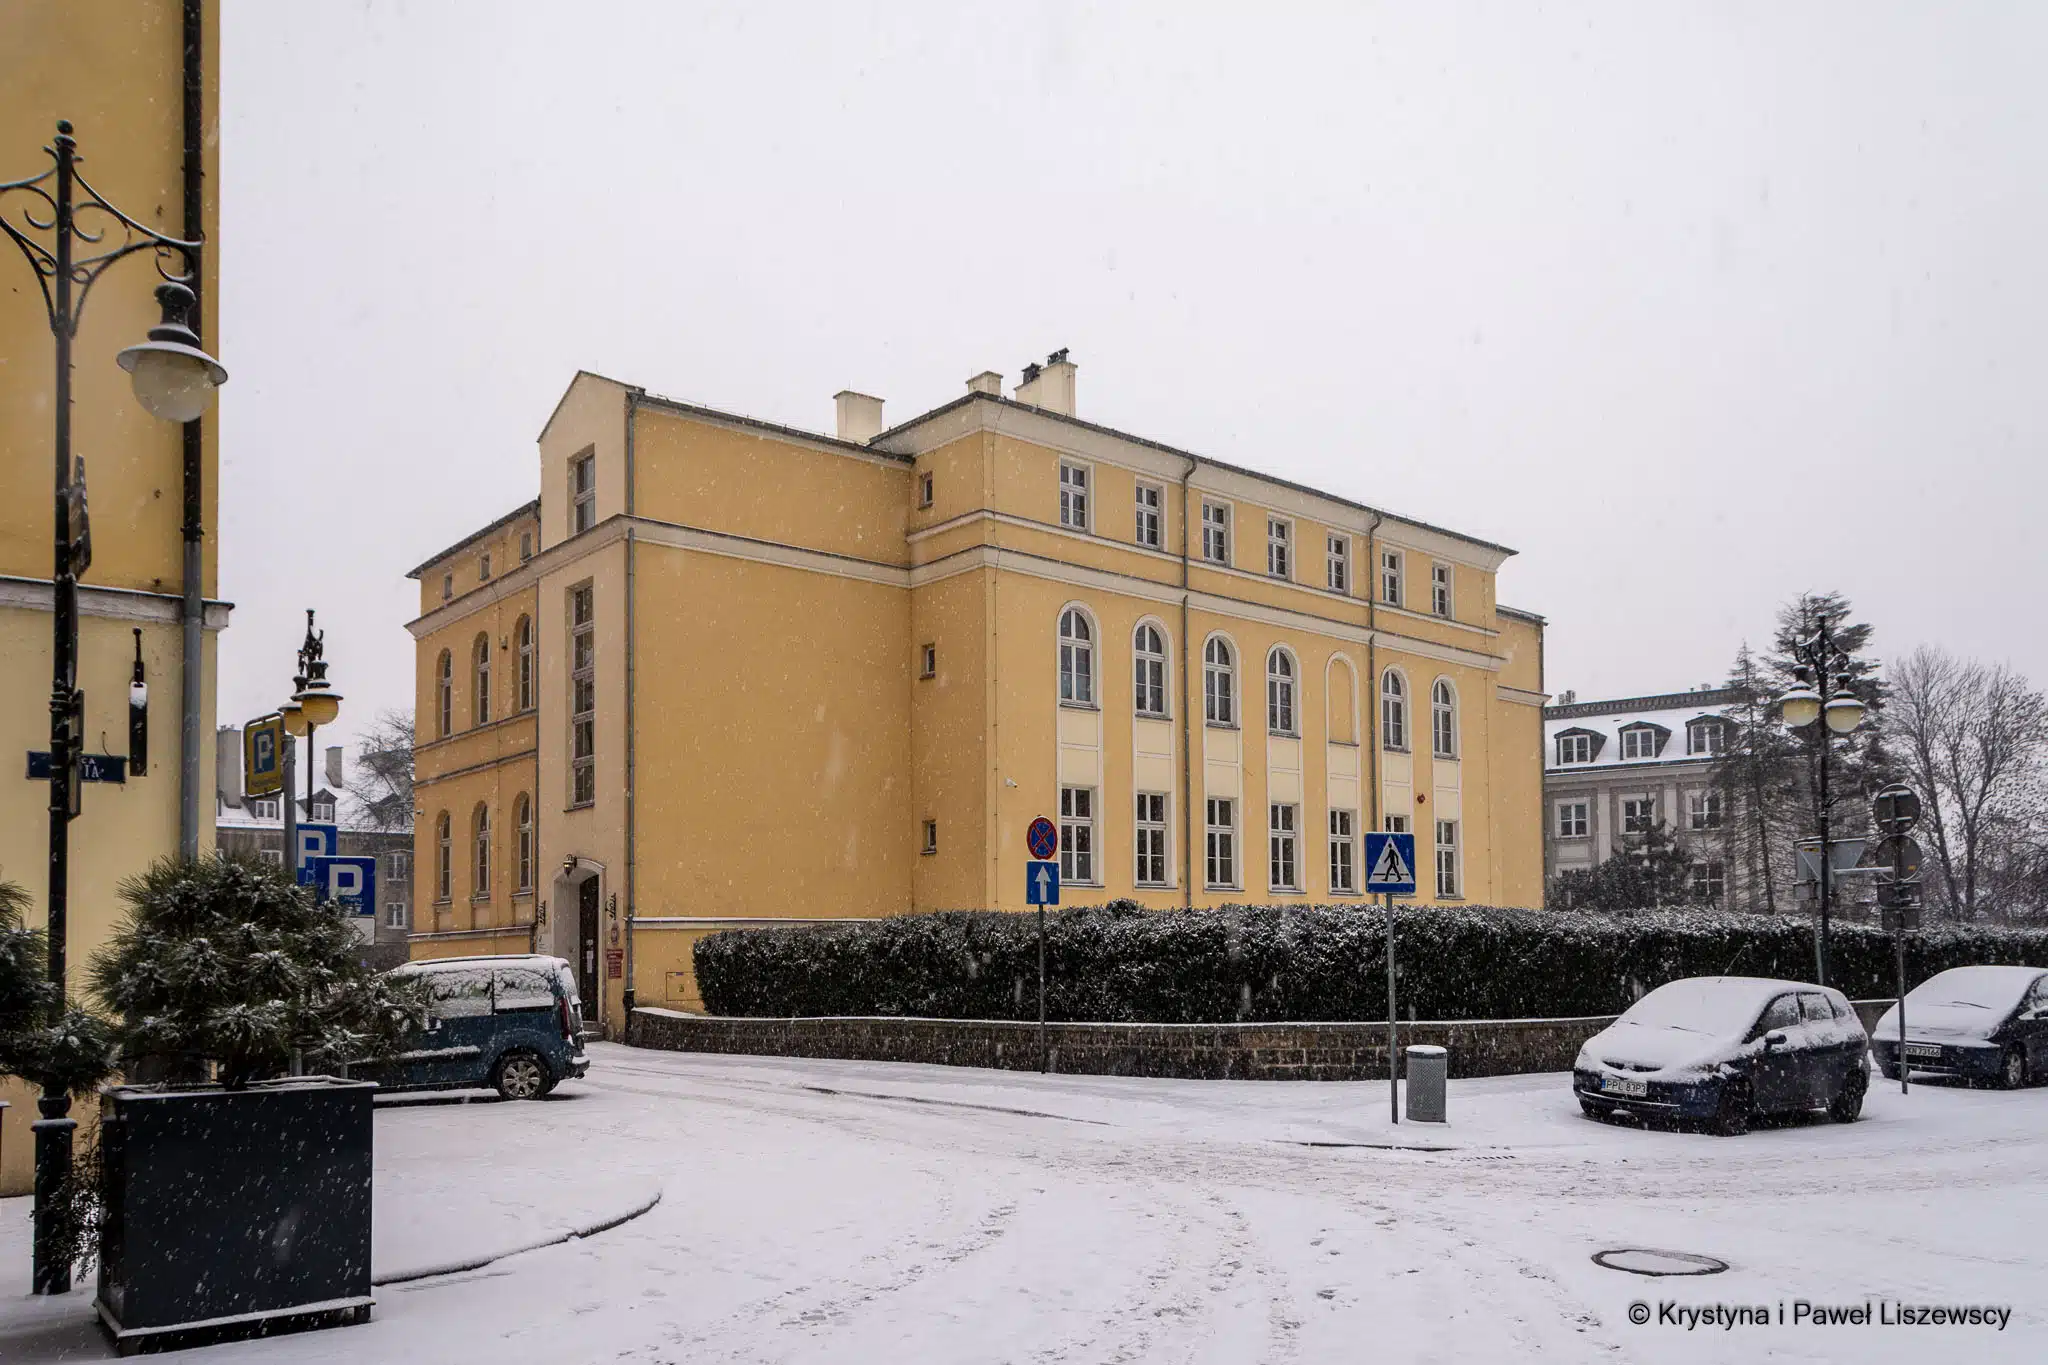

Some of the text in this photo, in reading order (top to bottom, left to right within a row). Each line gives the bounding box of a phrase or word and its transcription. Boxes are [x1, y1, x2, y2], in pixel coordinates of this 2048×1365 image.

[257, 734, 271, 769] P
[298, 829, 327, 869] P
[329, 864, 363, 899] P
[1606, 1080, 1623, 1091] PPL
